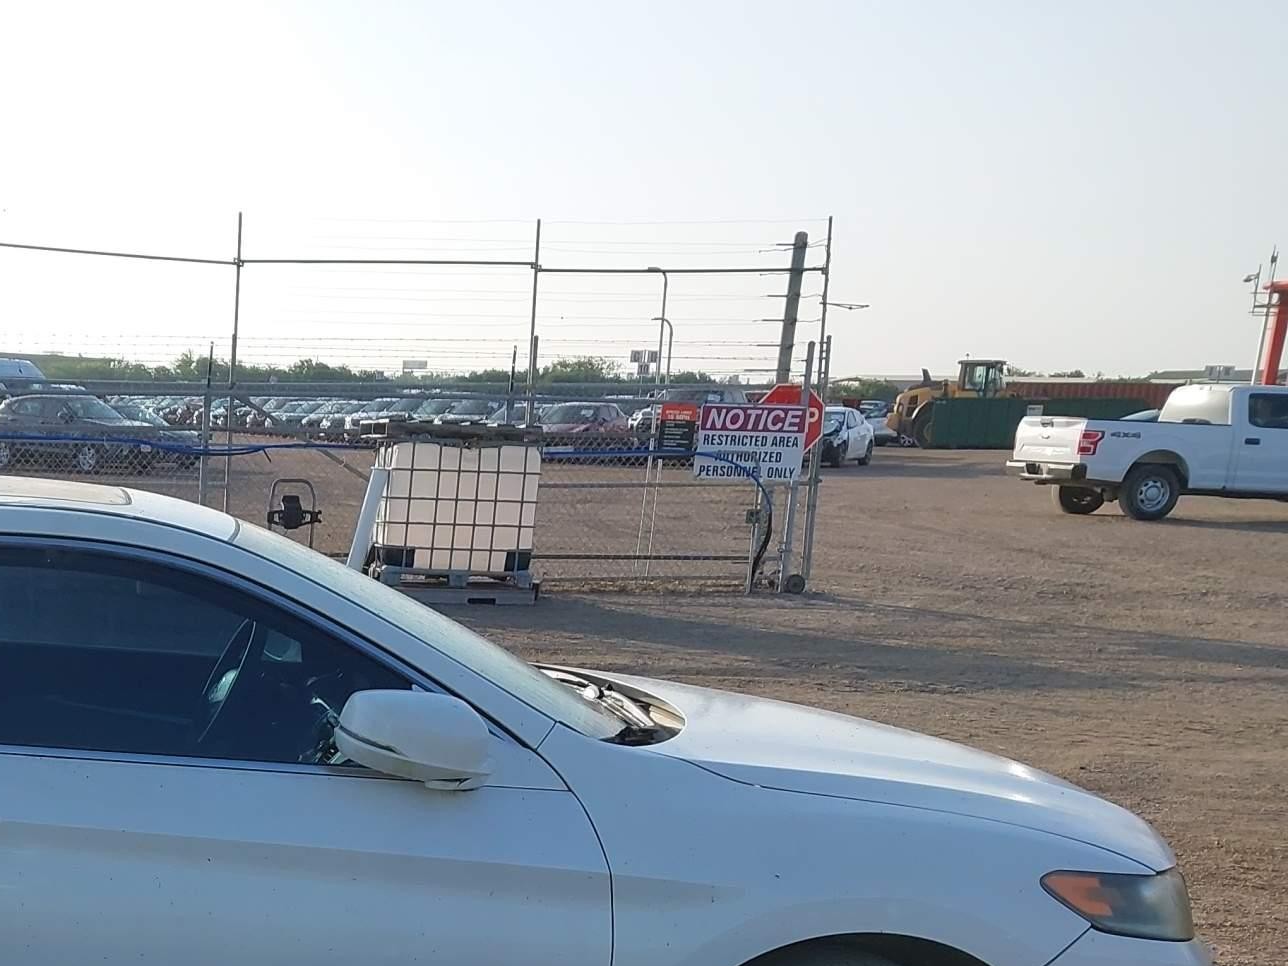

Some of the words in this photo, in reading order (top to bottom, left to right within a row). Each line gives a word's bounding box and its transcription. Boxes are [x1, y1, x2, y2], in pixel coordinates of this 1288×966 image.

[705, 408, 803, 431] NOTICE
[702, 433, 768, 447] RESTRICTED
[770, 436, 799, 448] AREA
[767, 466, 795, 479] ONLY
